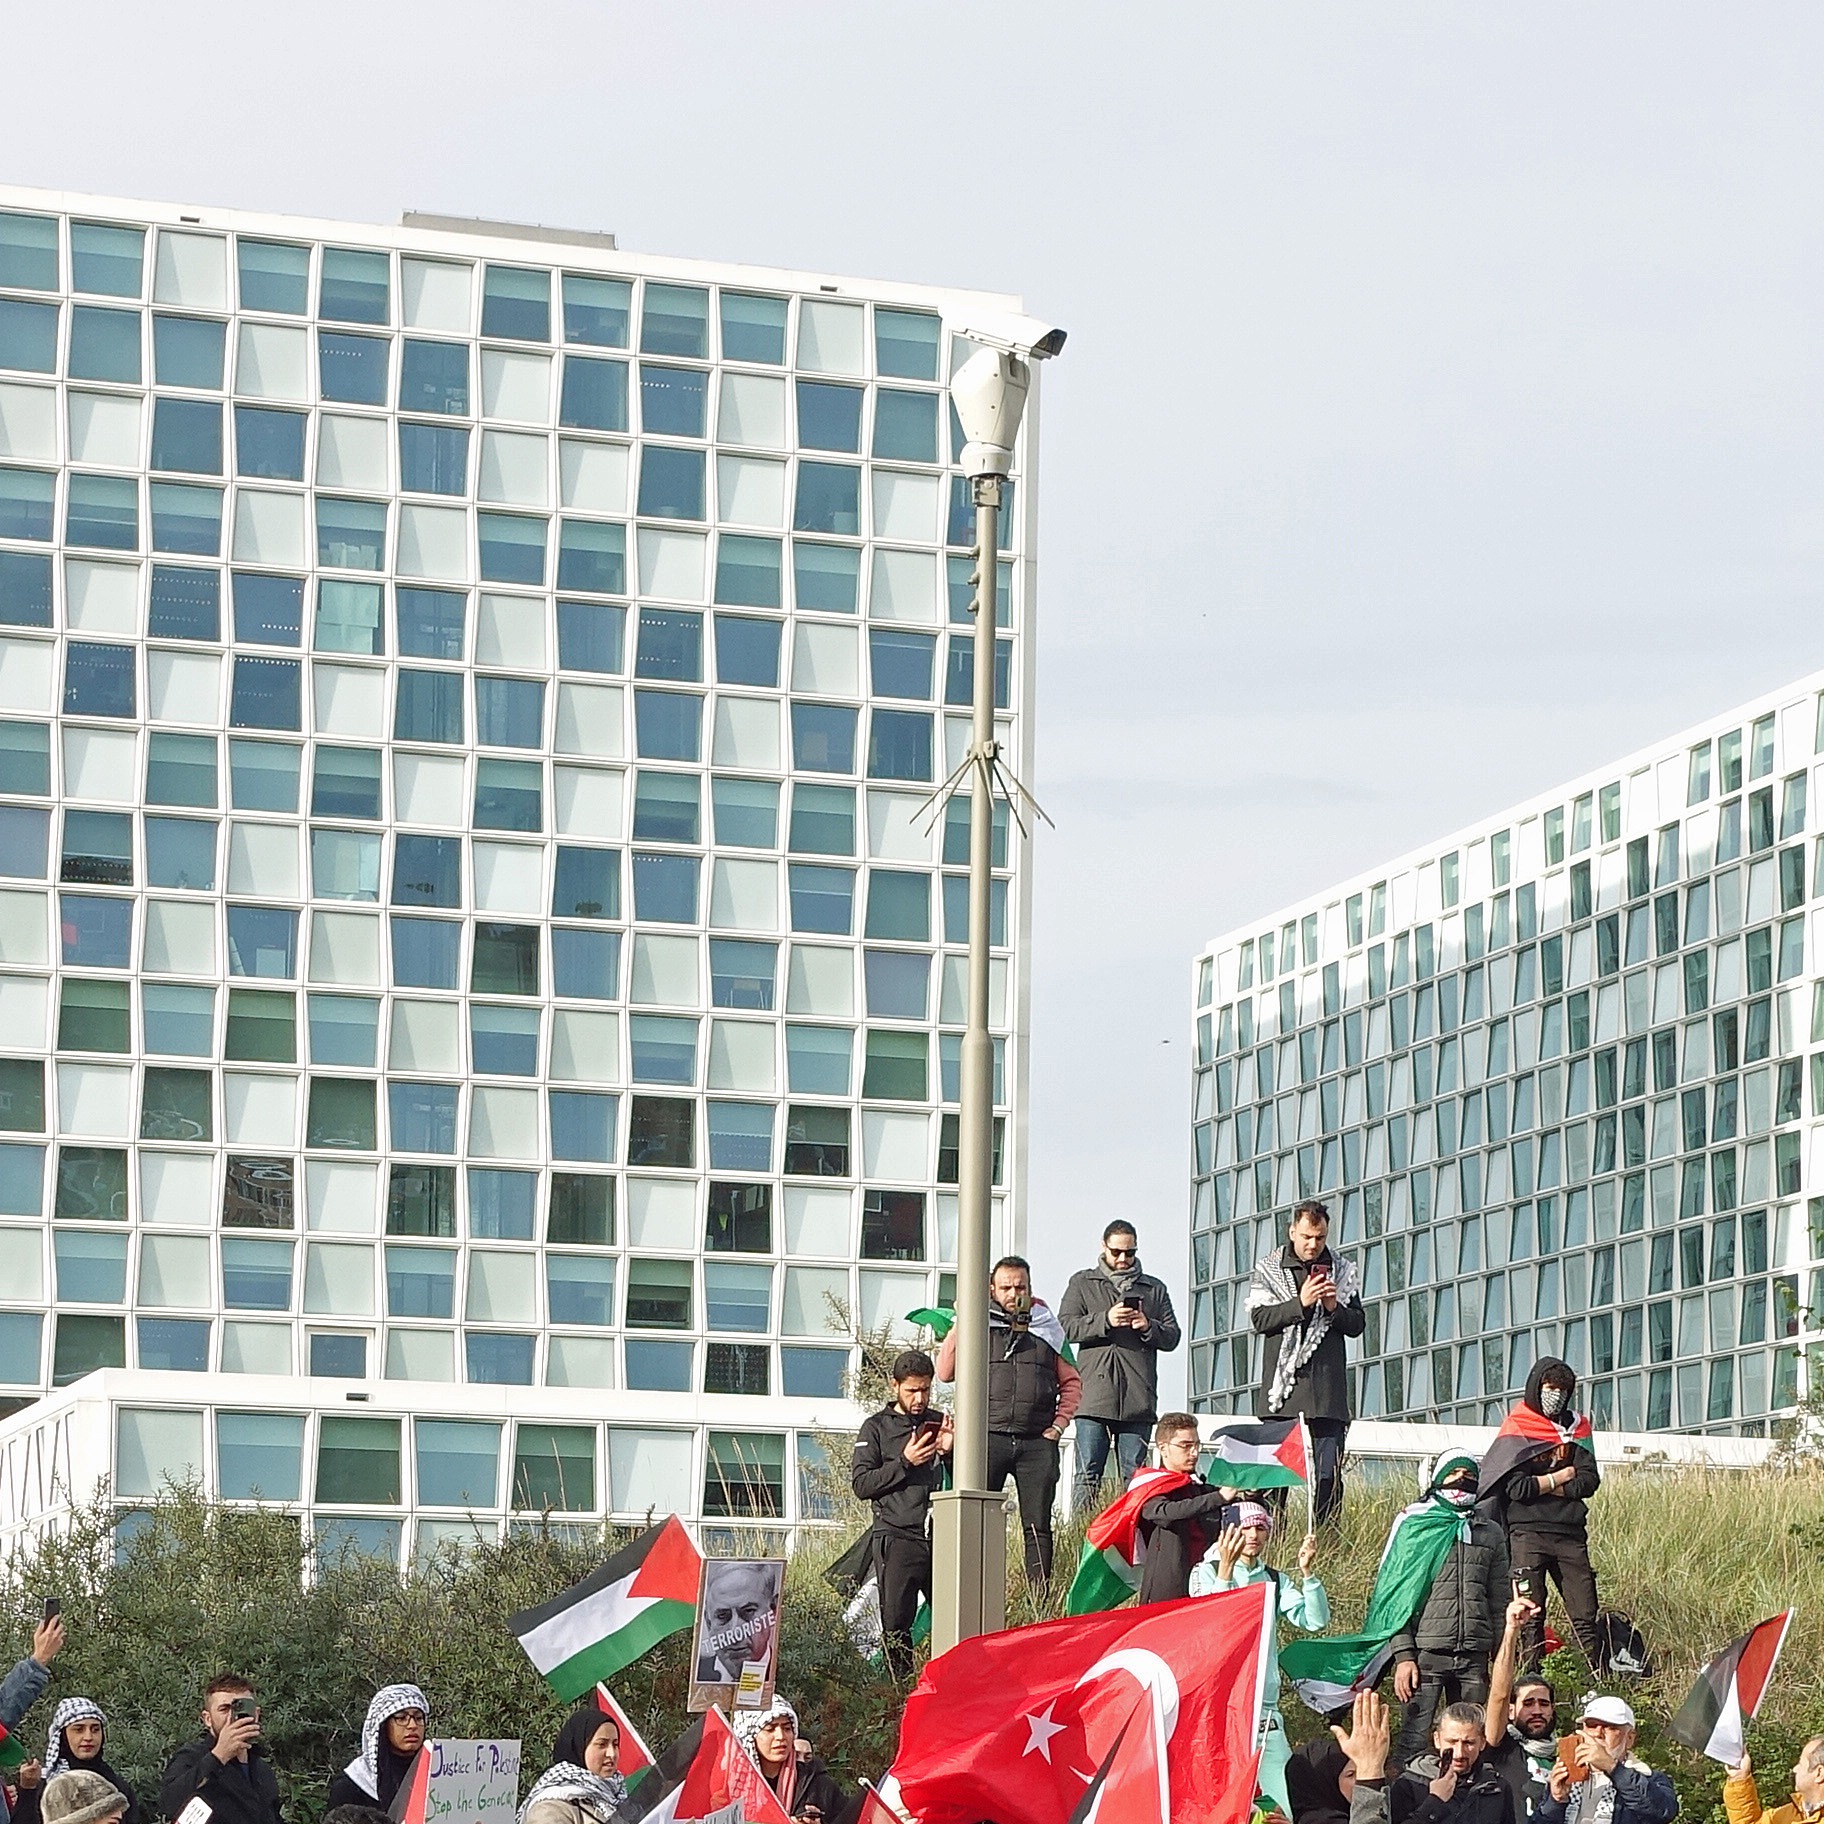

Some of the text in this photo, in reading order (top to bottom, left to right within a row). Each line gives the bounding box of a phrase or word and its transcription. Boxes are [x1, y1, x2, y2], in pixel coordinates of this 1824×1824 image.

[701, 1609, 776, 1654] TERRORISTE
[430, 1742, 470, 1778] Justice
[425, 1788, 452, 1823] Stop
[457, 1788, 473, 1812] the
